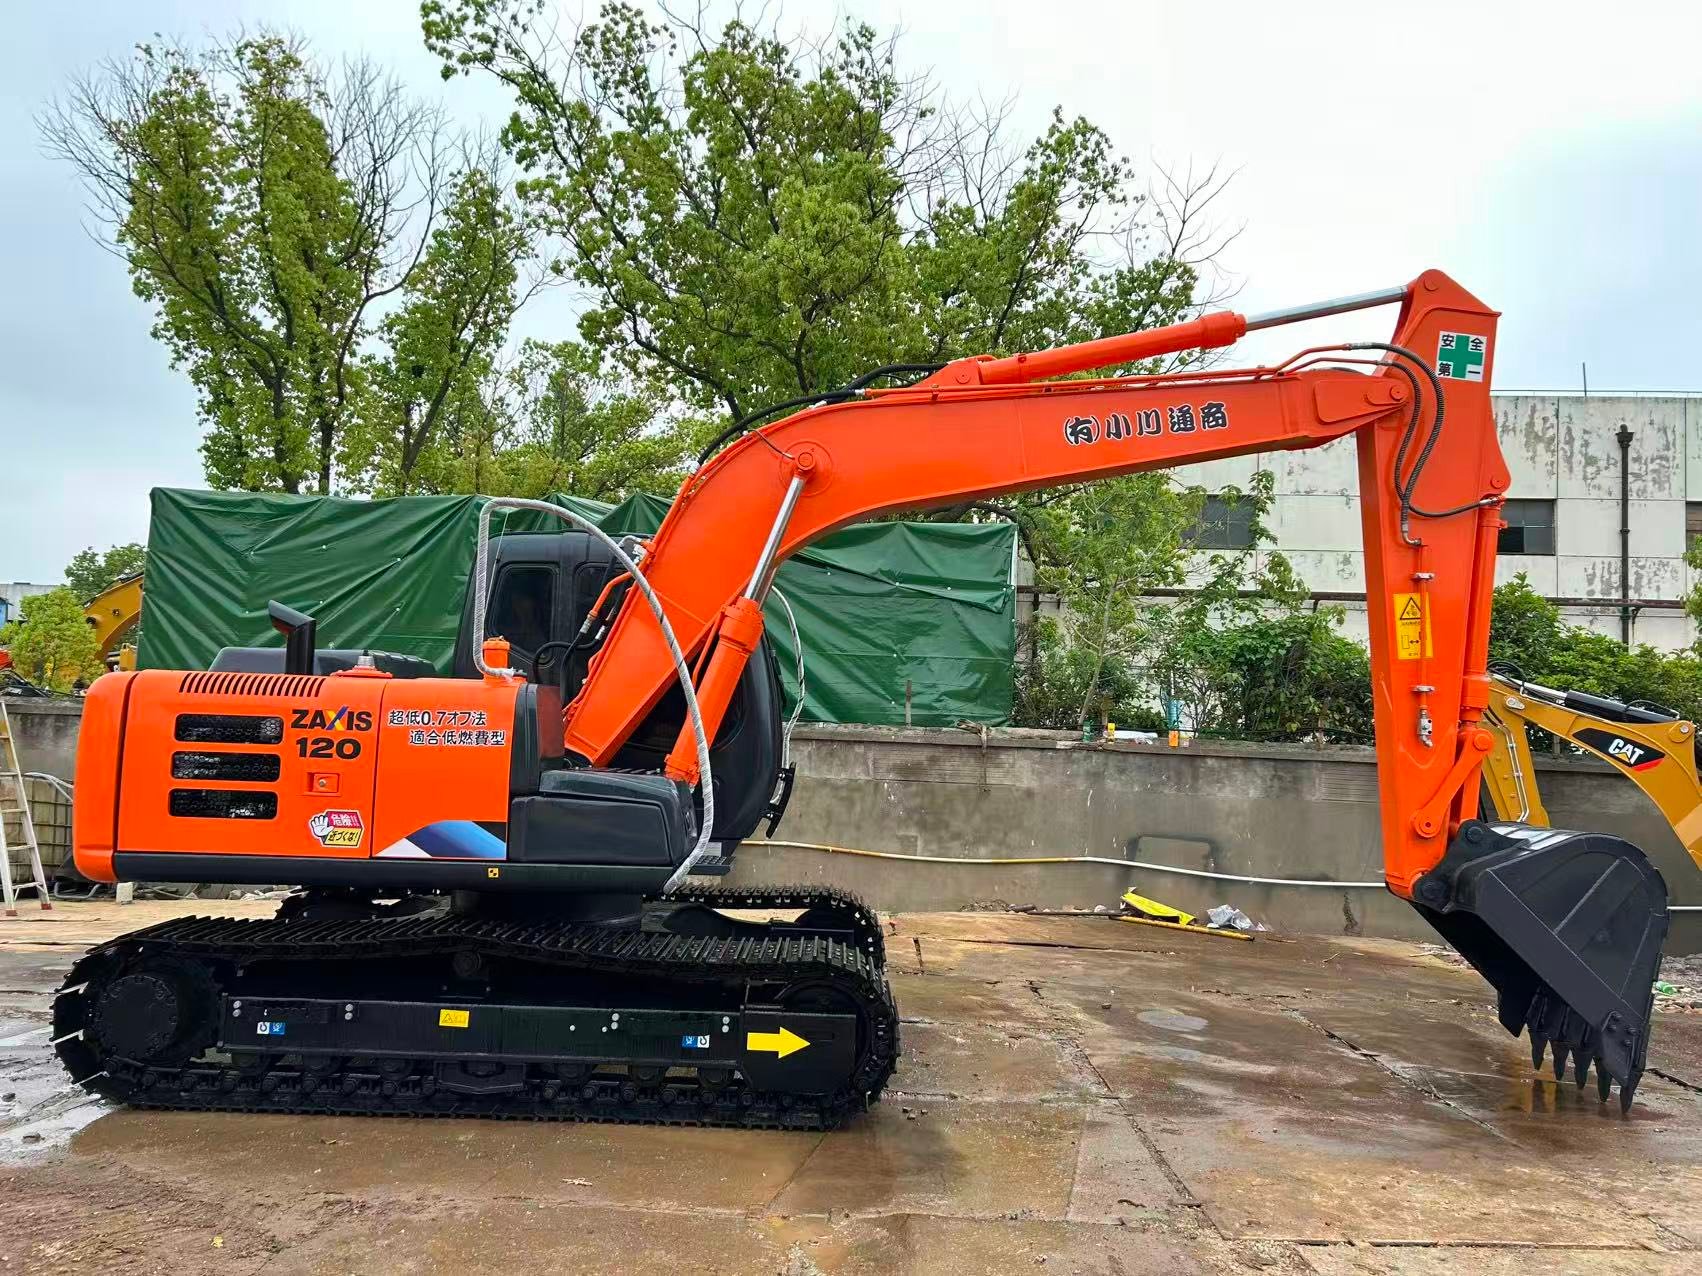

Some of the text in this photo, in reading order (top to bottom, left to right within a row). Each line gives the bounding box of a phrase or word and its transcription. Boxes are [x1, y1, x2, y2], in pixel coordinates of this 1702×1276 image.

[291, 706, 372, 731] ZAXIS
[296, 738, 361, 759] 120
[410, 730, 505, 745] 適合低燃費型
[1608, 739, 1644, 764] CAT
